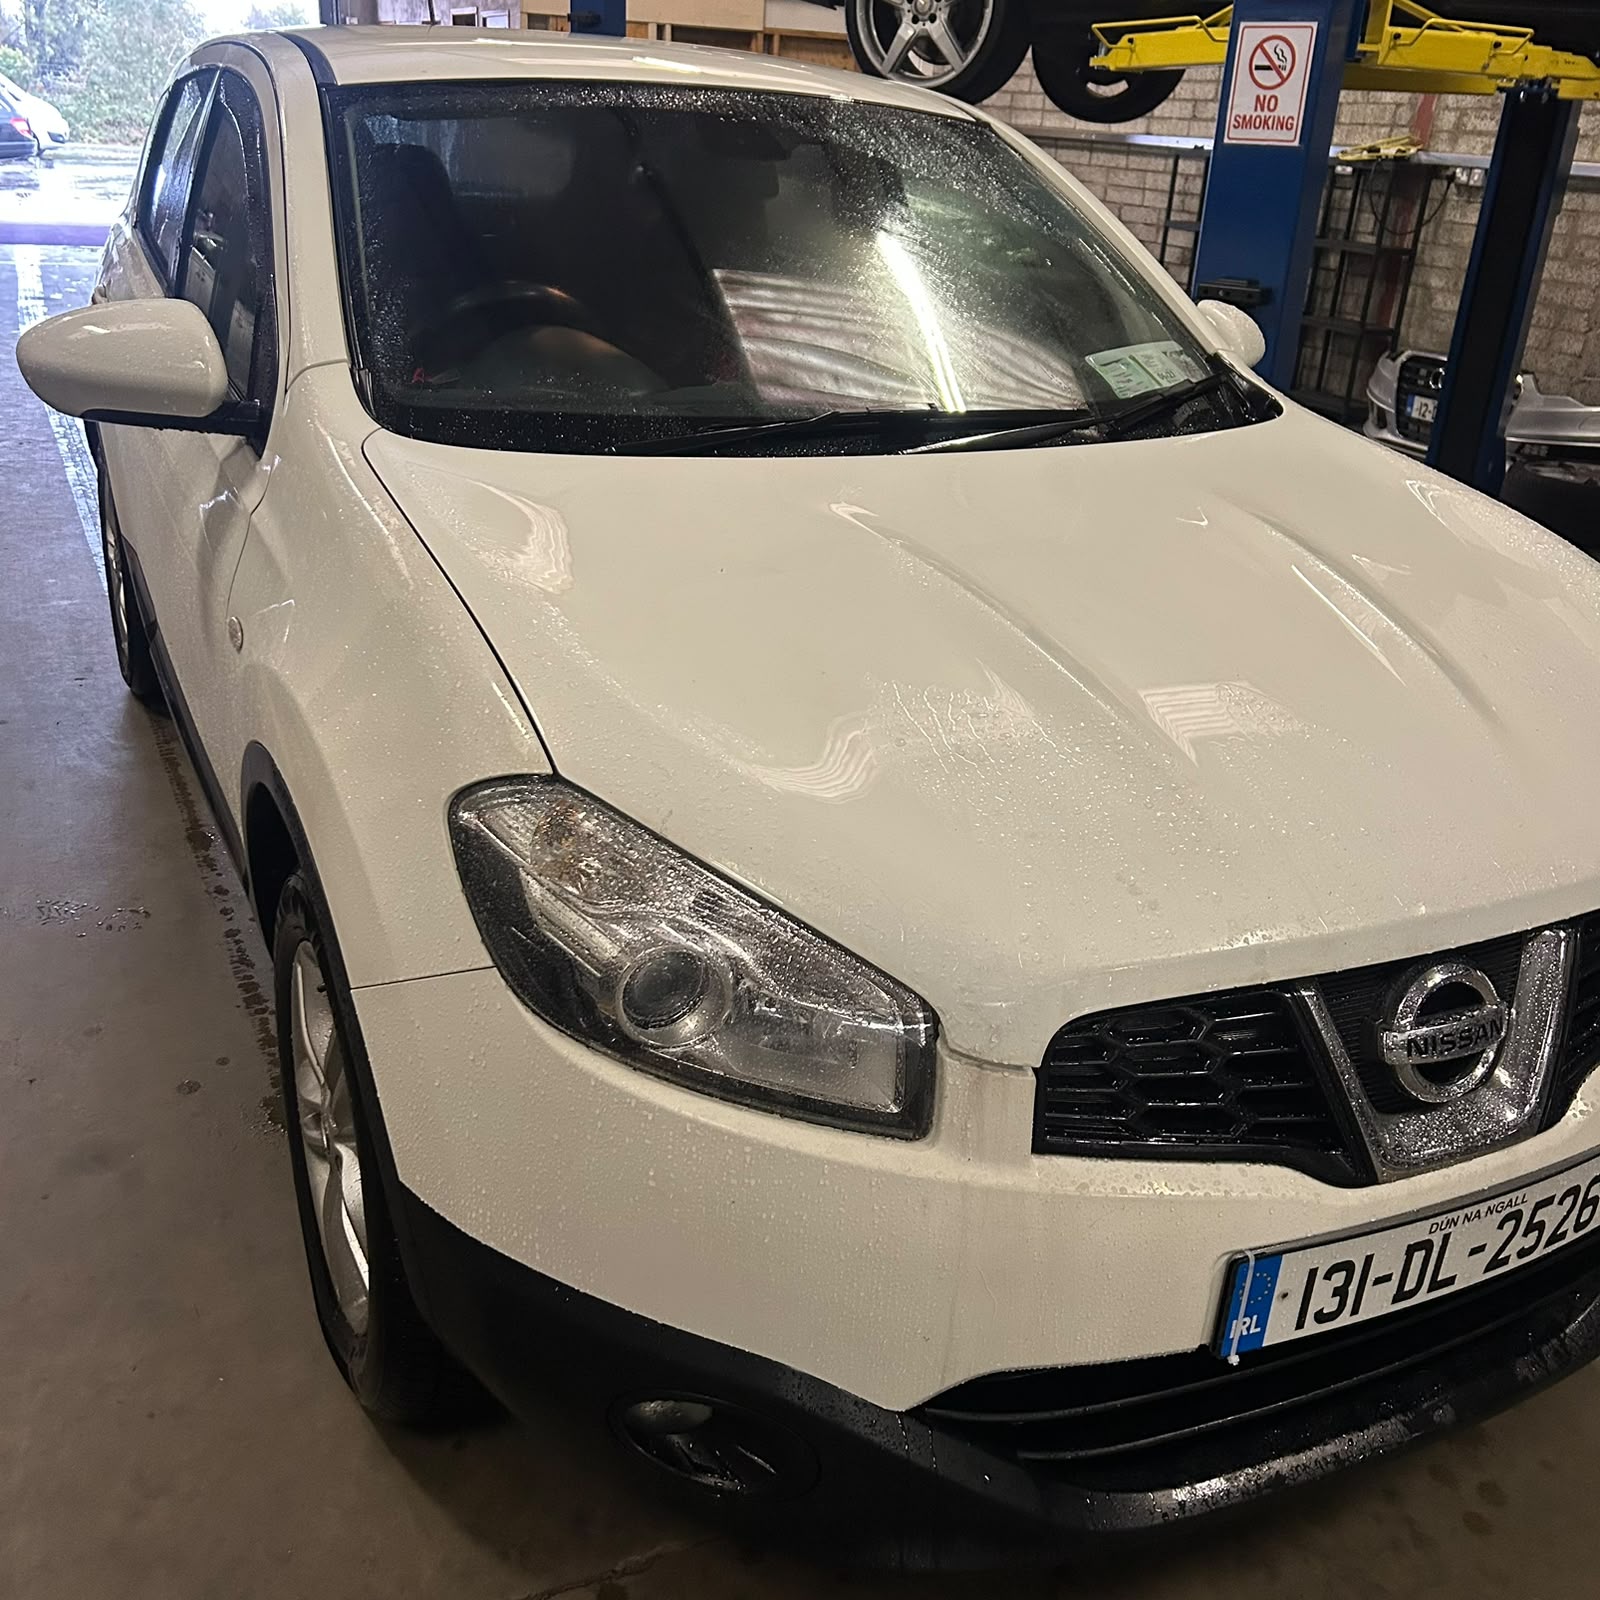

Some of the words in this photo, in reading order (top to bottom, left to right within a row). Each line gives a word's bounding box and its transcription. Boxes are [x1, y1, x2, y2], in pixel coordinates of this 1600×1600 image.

[1254, 94, 1279, 113] NO
[1232, 114, 1295, 132] SMOKING
[1407, 1017, 1503, 1058] NISSAN
[1428, 1215, 1460, 1235] DÚN
[1462, 1209, 1481, 1225] NA
[1484, 1193, 1528, 1217] NGALL
[1229, 1314, 1261, 1339] IRL
